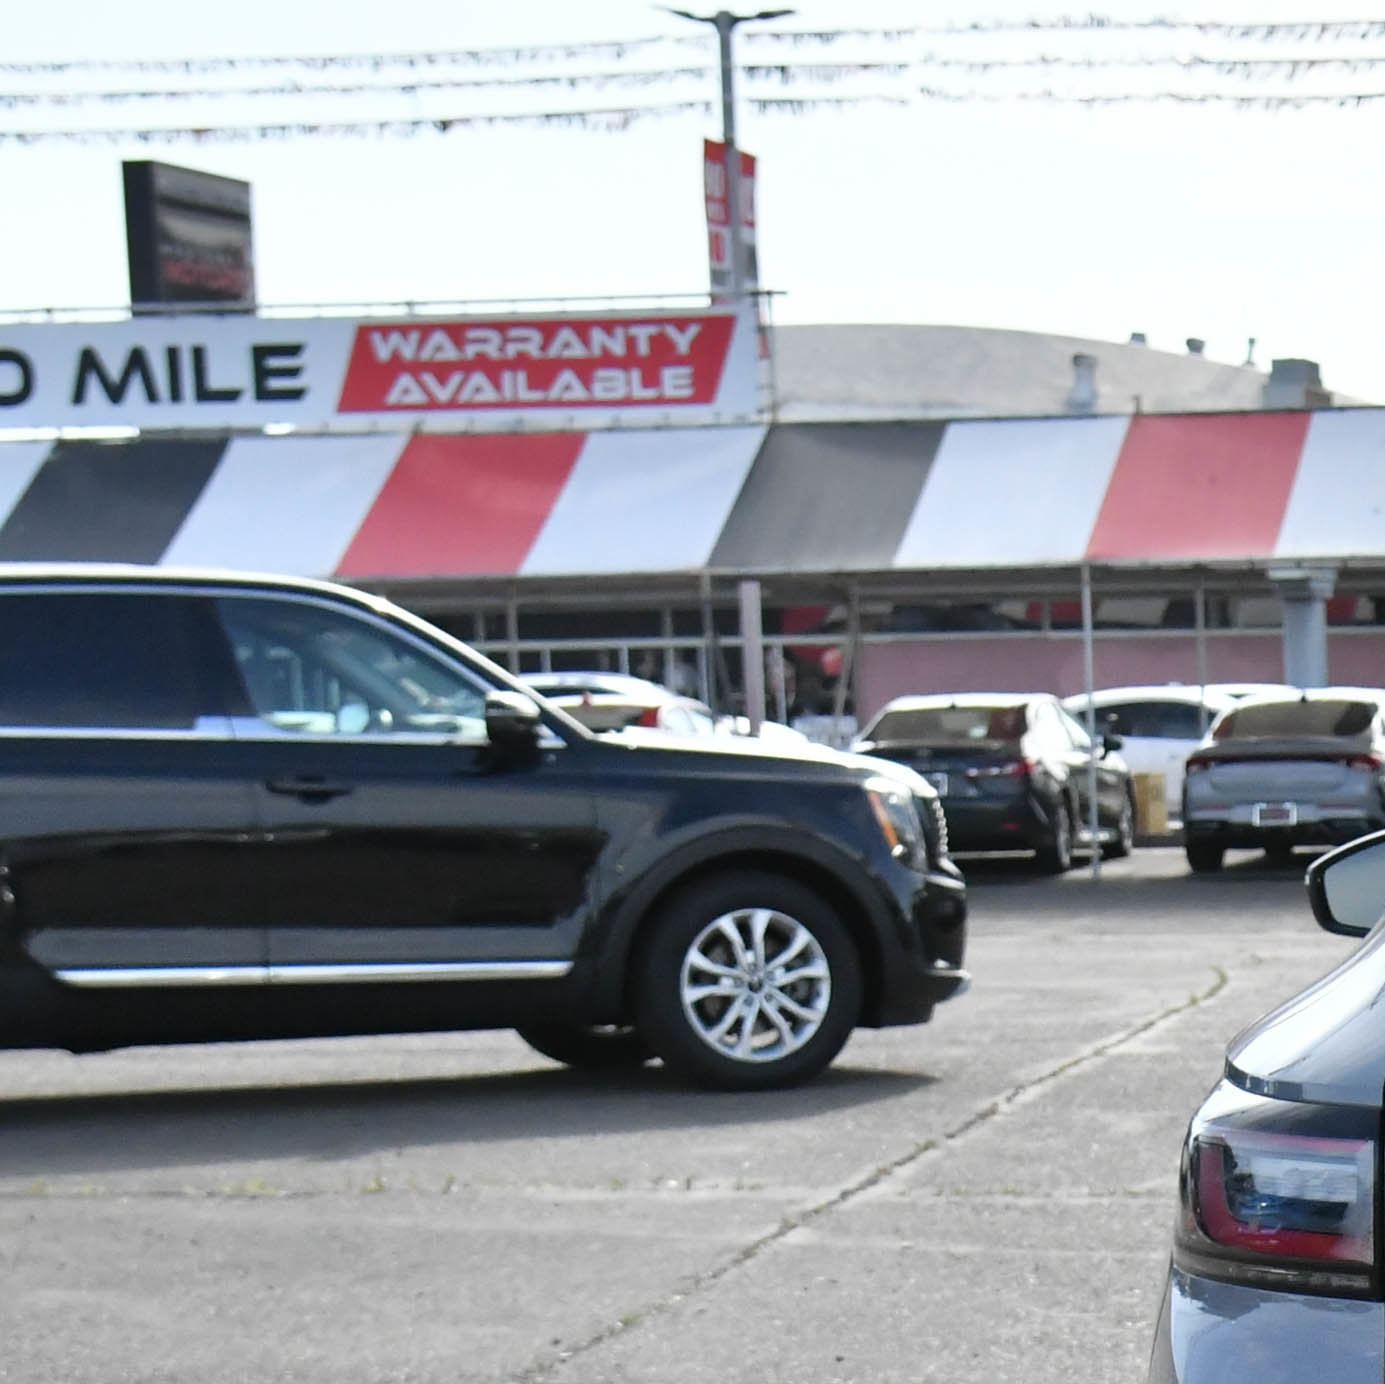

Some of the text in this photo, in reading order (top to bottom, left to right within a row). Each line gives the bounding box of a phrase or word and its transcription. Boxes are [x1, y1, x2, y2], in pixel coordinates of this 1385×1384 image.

[368, 322, 702, 363] WARRANTY
[72, 344, 309, 405] MILE
[385, 365, 695, 406] AVAILABLE
